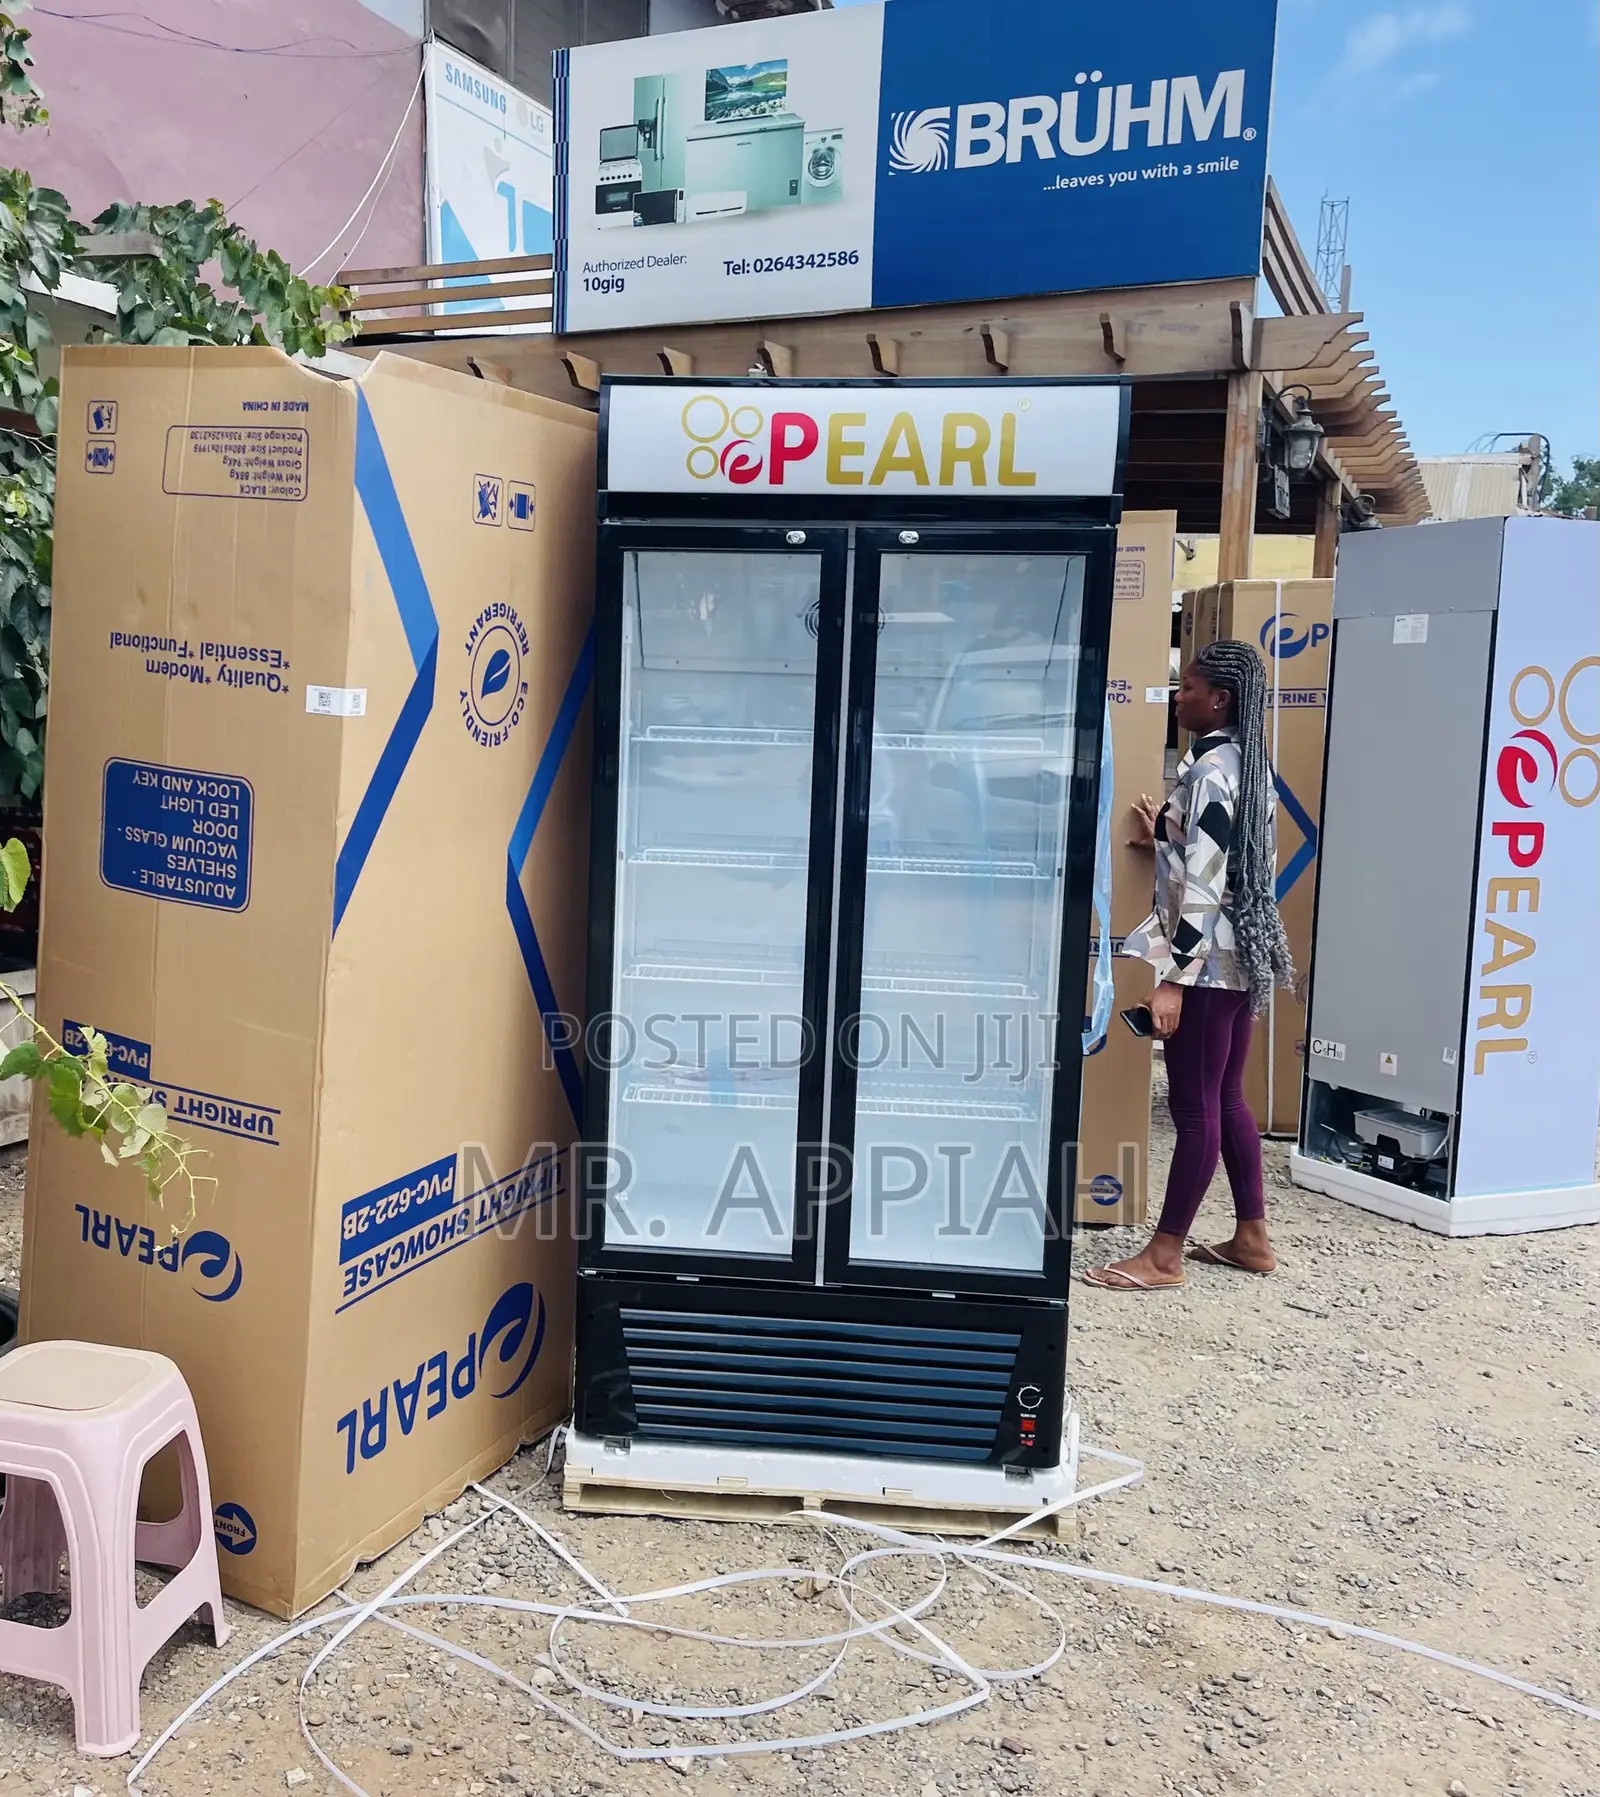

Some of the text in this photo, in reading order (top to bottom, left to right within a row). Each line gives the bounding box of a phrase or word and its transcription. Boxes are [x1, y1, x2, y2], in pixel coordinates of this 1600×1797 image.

[445, 62, 506, 114] SAMSUNG
[530, 111, 544, 133] LG
[954, 69, 1245, 169] BRÜHM
[1108, 170, 1137, 188] you
[1141, 162, 1178, 180] with
[1182, 164, 1192, 176] a
[1197, 156, 1239, 174] smile
[582, 253, 688, 274] Authorized Dealer:
[723, 250, 859, 276] Tel: 0264342586
[583, 274, 625, 294] 10gig
[242, 401, 309, 412] MADE IN CHINA
[245, 431, 263, 441] Size:
[247, 444, 268, 454] Size:
[264, 431, 303, 442] Package
[768, 411, 1037, 487] PEARL
[222, 455, 302, 470] Gross Weight: 94Kg
[269, 445, 303, 456] Product
[253, 470, 283, 482] Weight:
[285, 473, 302, 483] Net
[239, 484, 266, 496] BLACK
[464, 602, 530, 657] REFRIGERANT
[459, 681, 529, 748] ECO-FRIENDLY
[132, 769, 240, 801] LOCK AND KEY
[160, 794, 239, 820] LED LIGHT
[125, 825, 168, 848] GLASS
[192, 819, 238, 840] DOOR
[171, 835, 238, 860] VACUUM
[166, 853, 237, 879] SHELVES
[140, 868, 237, 900] ADJUSTABLE
[1474, 821, 1545, 1076] PEARL
[64, 1029, 149, 1069] PVC-6-2B
[173, 1096, 273, 1136] UPRIGHT
[343, 1166, 454, 1240] PVC-622-2B
[75, 1203, 180, 1273] PEARL
[343, 1162, 562, 1298] UPRIGHT SHOWCASE
[336, 1331, 477, 1475] PEARL
[214, 1519, 246, 1538] FRONT
